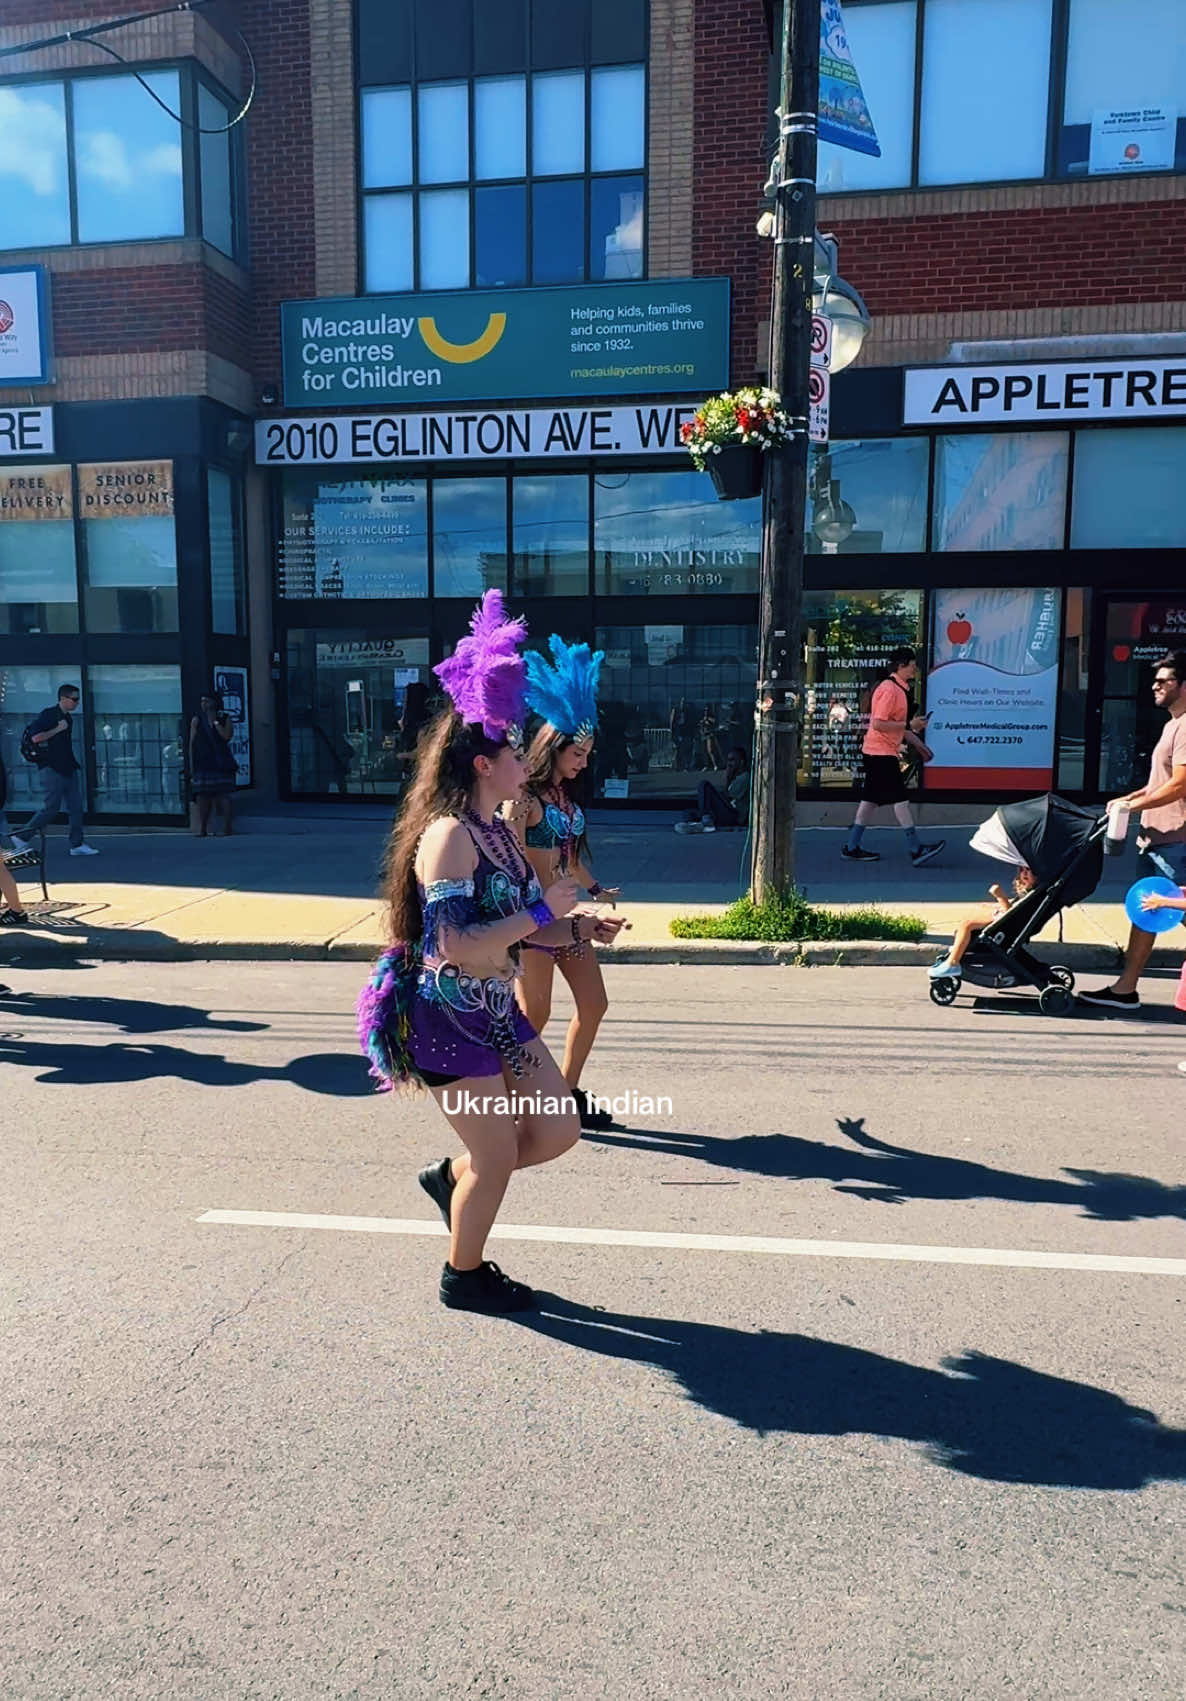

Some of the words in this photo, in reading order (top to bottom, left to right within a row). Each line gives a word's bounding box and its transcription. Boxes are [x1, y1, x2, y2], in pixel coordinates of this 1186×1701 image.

[570, 307, 615, 321] Helping
[617, 305, 645, 318] kids,
[648, 302, 692, 316] families
[301, 313, 415, 338] Macaulay
[570, 325, 592, 336] and
[595, 320, 669, 335] communities
[672, 318, 704, 331] thrive
[302, 342, 395, 365] Centres
[570, 341, 601, 352] since
[604, 339, 634, 350] 1932.
[302, 369, 336, 391] for
[341, 365, 442, 389] Children
[570, 362, 695, 378] macaulaycentres.org
[931, 368, 1186, 413] APPLETRE
[0, 411, 43, 450] RE
[266, 422, 338, 460] 2010
[351, 413, 530, 458] EGLINTON
[544, 411, 621, 452] AVE.
[8, 478, 45, 489] FREE
[96, 474, 157, 487] SENIOR
[284, 527, 306, 537] OUR
[308, 526, 357, 537] SERVICES
[360, 524, 410, 536] INCLUDE:
